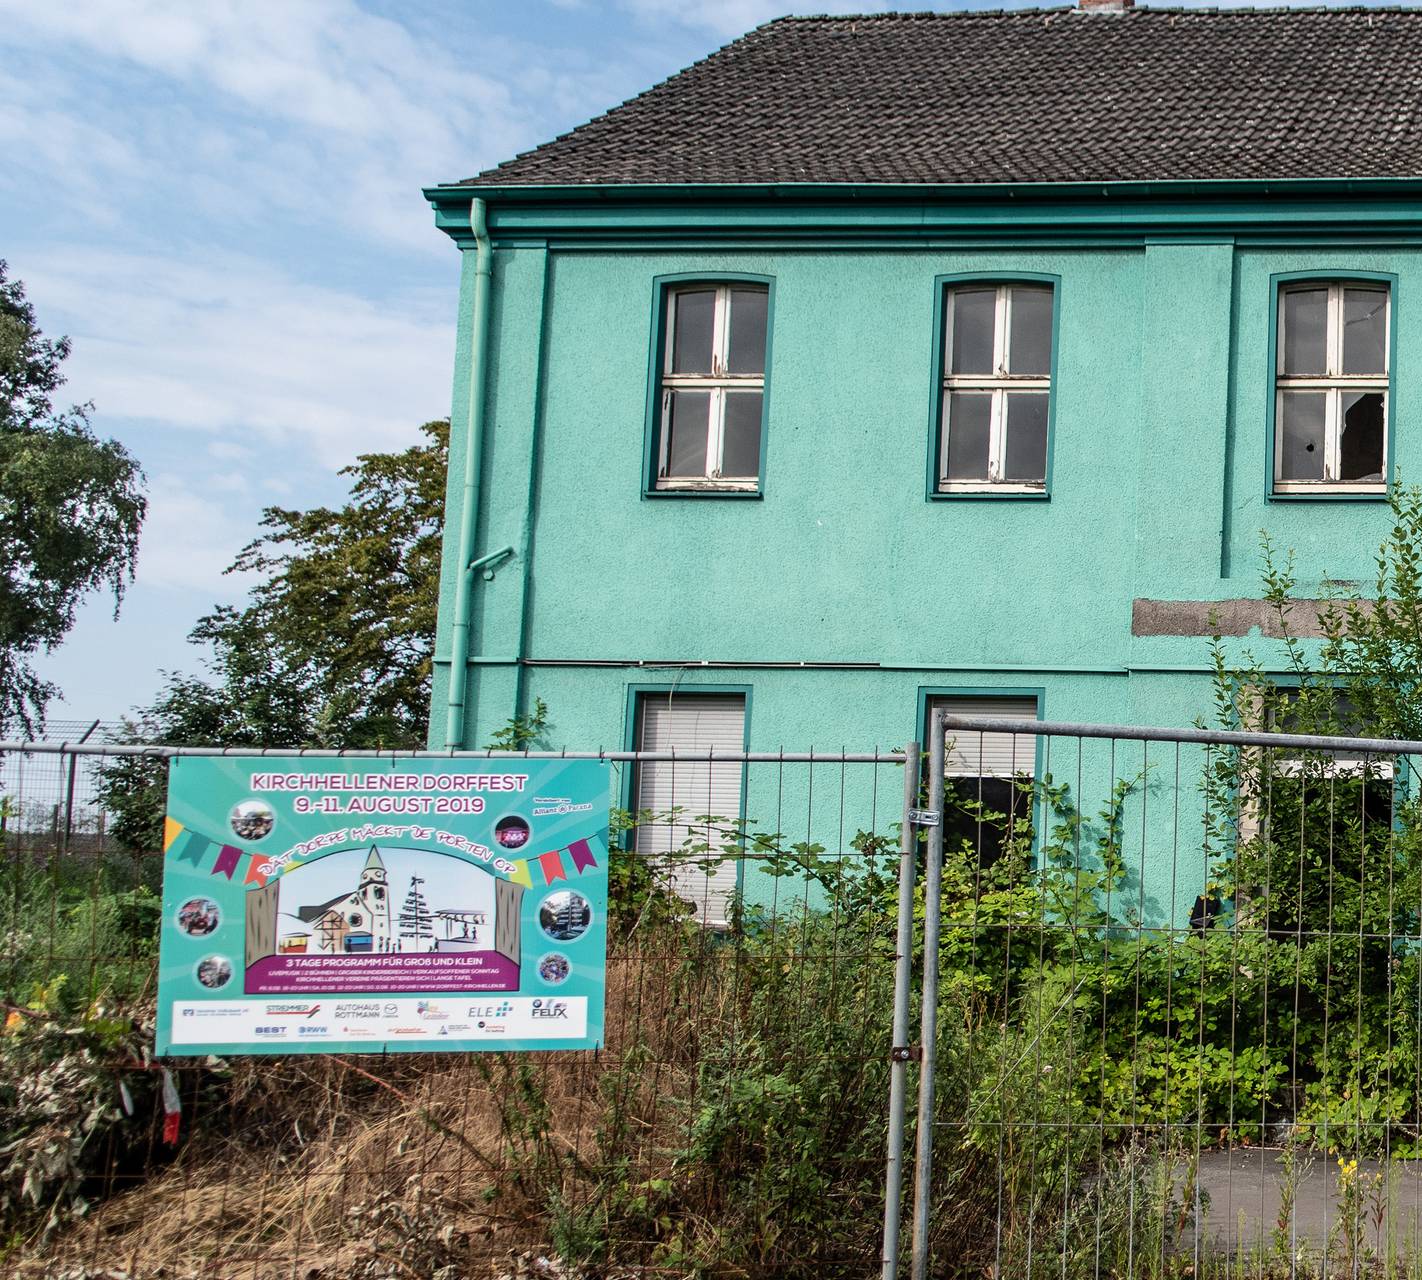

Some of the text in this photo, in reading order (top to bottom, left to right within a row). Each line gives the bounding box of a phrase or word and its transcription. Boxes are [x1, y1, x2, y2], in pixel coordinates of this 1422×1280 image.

[252, 774, 528, 790] KIRCHHELLENER DORFFEST
[295, 797, 484, 813] 9.-11. AUGUST 2019
[411, 825, 434, 840] DE
[437, 831, 494, 861] PORTEN
[495, 859, 517, 873] OP
[286, 958, 294, 968] 3
[295, 958, 322, 967] TAGE
[322, 957, 382, 967] PROGRAMM
[382, 956, 403, 967] FÜR
[432, 956, 455, 966] UND
[454, 956, 483, 966] KLEIN
[265, 1004, 310, 1012] STREMMER
[336, 1003, 380, 1011] AUTOHAUS
[468, 1006, 494, 1018] ELE
[334, 1011, 380, 1019] ROTTMANN
[531, 1008, 569, 1020] FELIX
[255, 1026, 288, 1034] BEST
